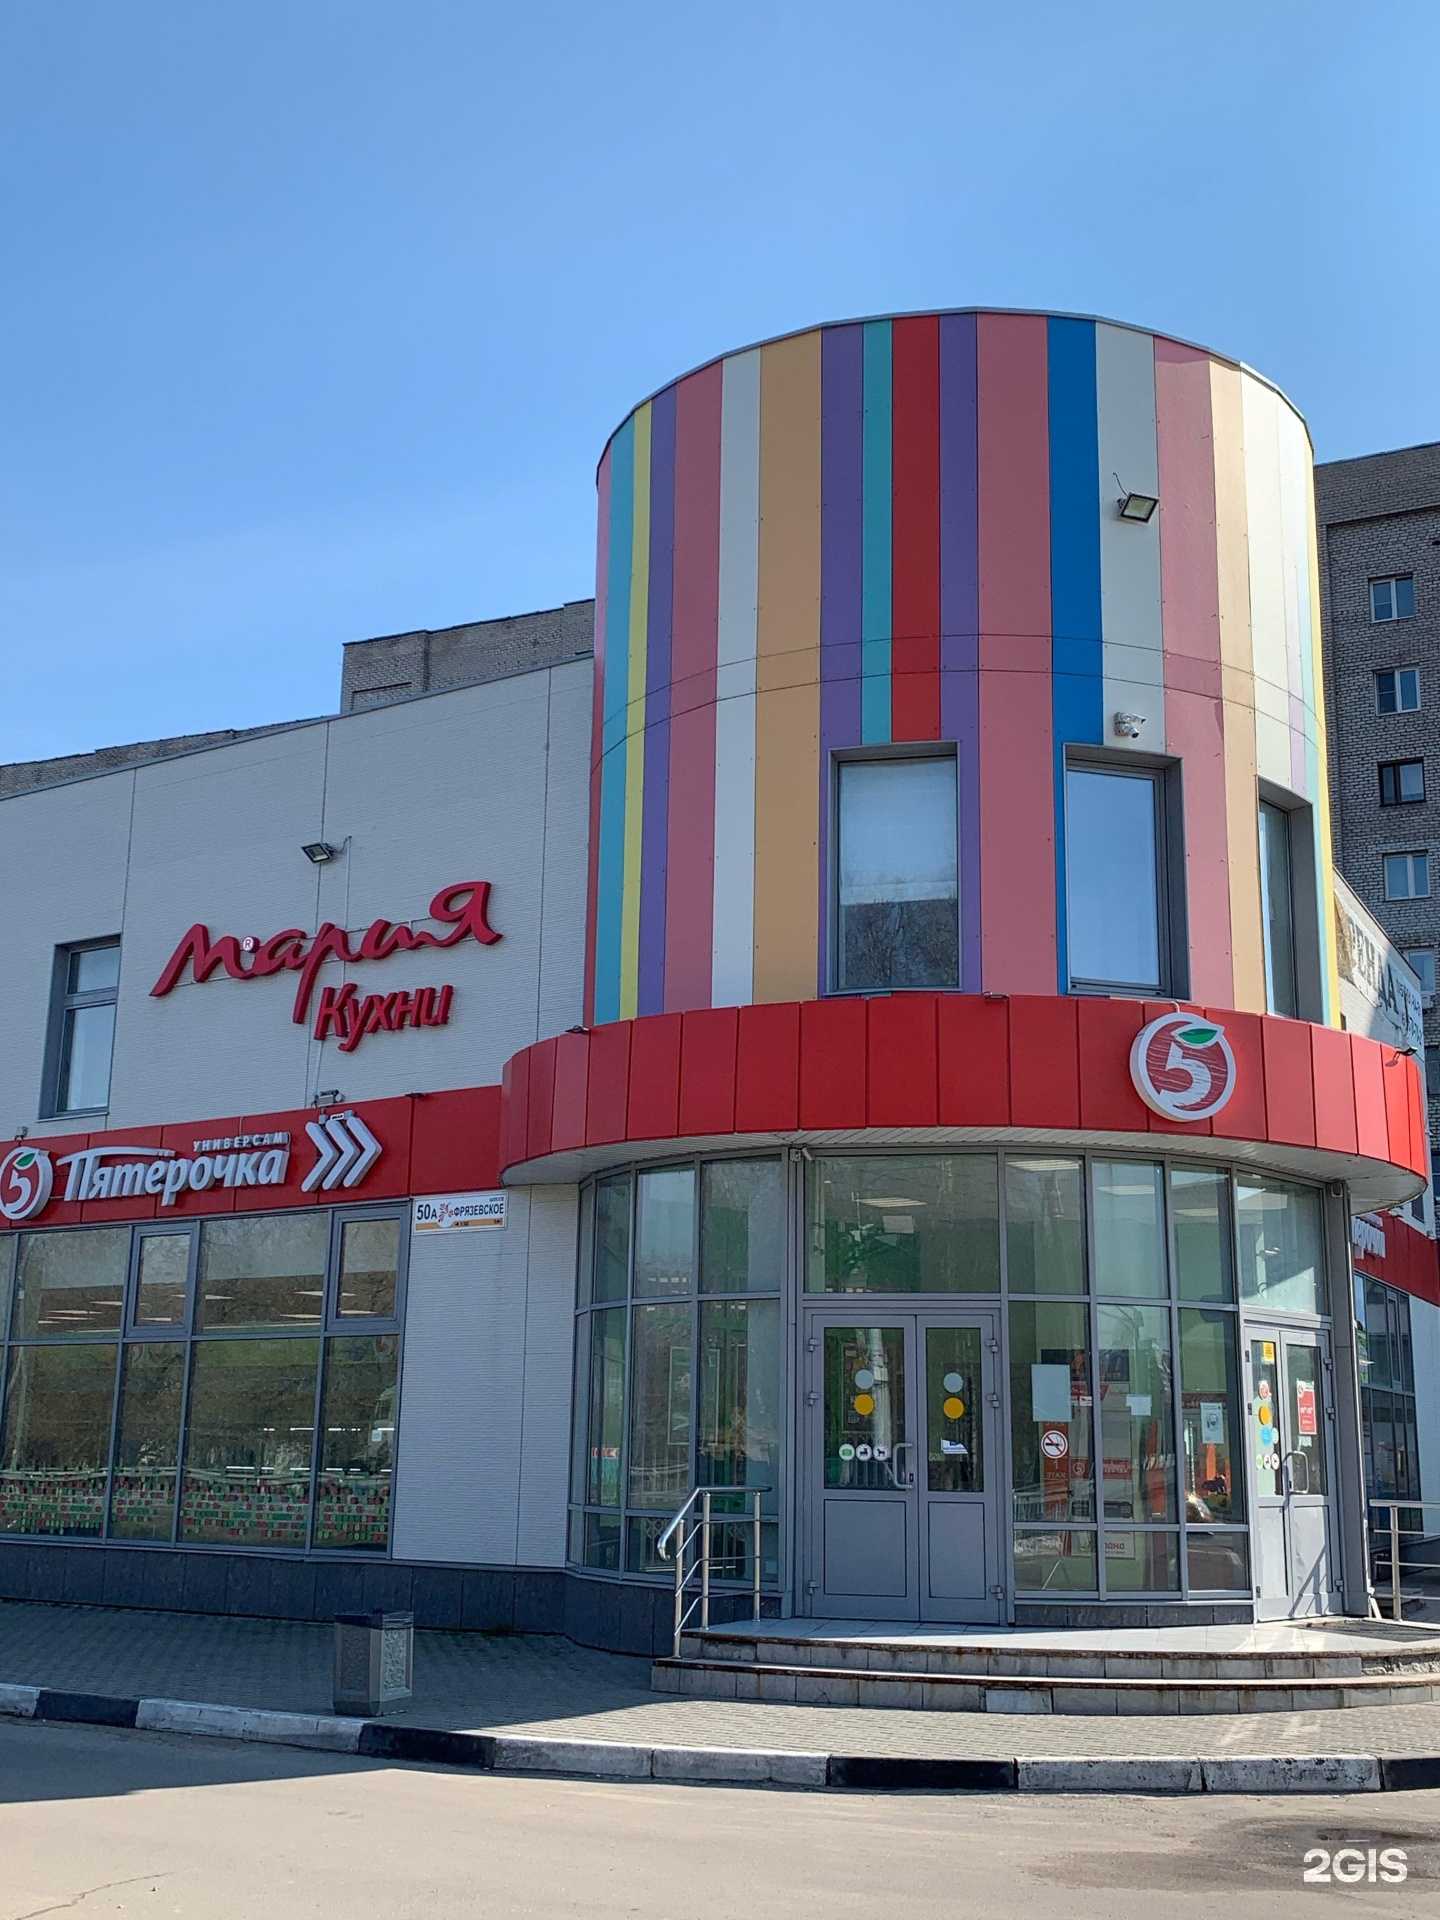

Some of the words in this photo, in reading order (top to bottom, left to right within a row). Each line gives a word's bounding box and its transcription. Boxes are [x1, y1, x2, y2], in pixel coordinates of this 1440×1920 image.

[149, 881, 502, 1024] Мария
[313, 983, 453, 1052] Кухни
[193, 1132, 290, 1152] УНИВЕРСАМ
[416, 1204, 437, 1220] 50А
[454, 1203, 504, 1217] ФРЯЗЕВСКОЕ
